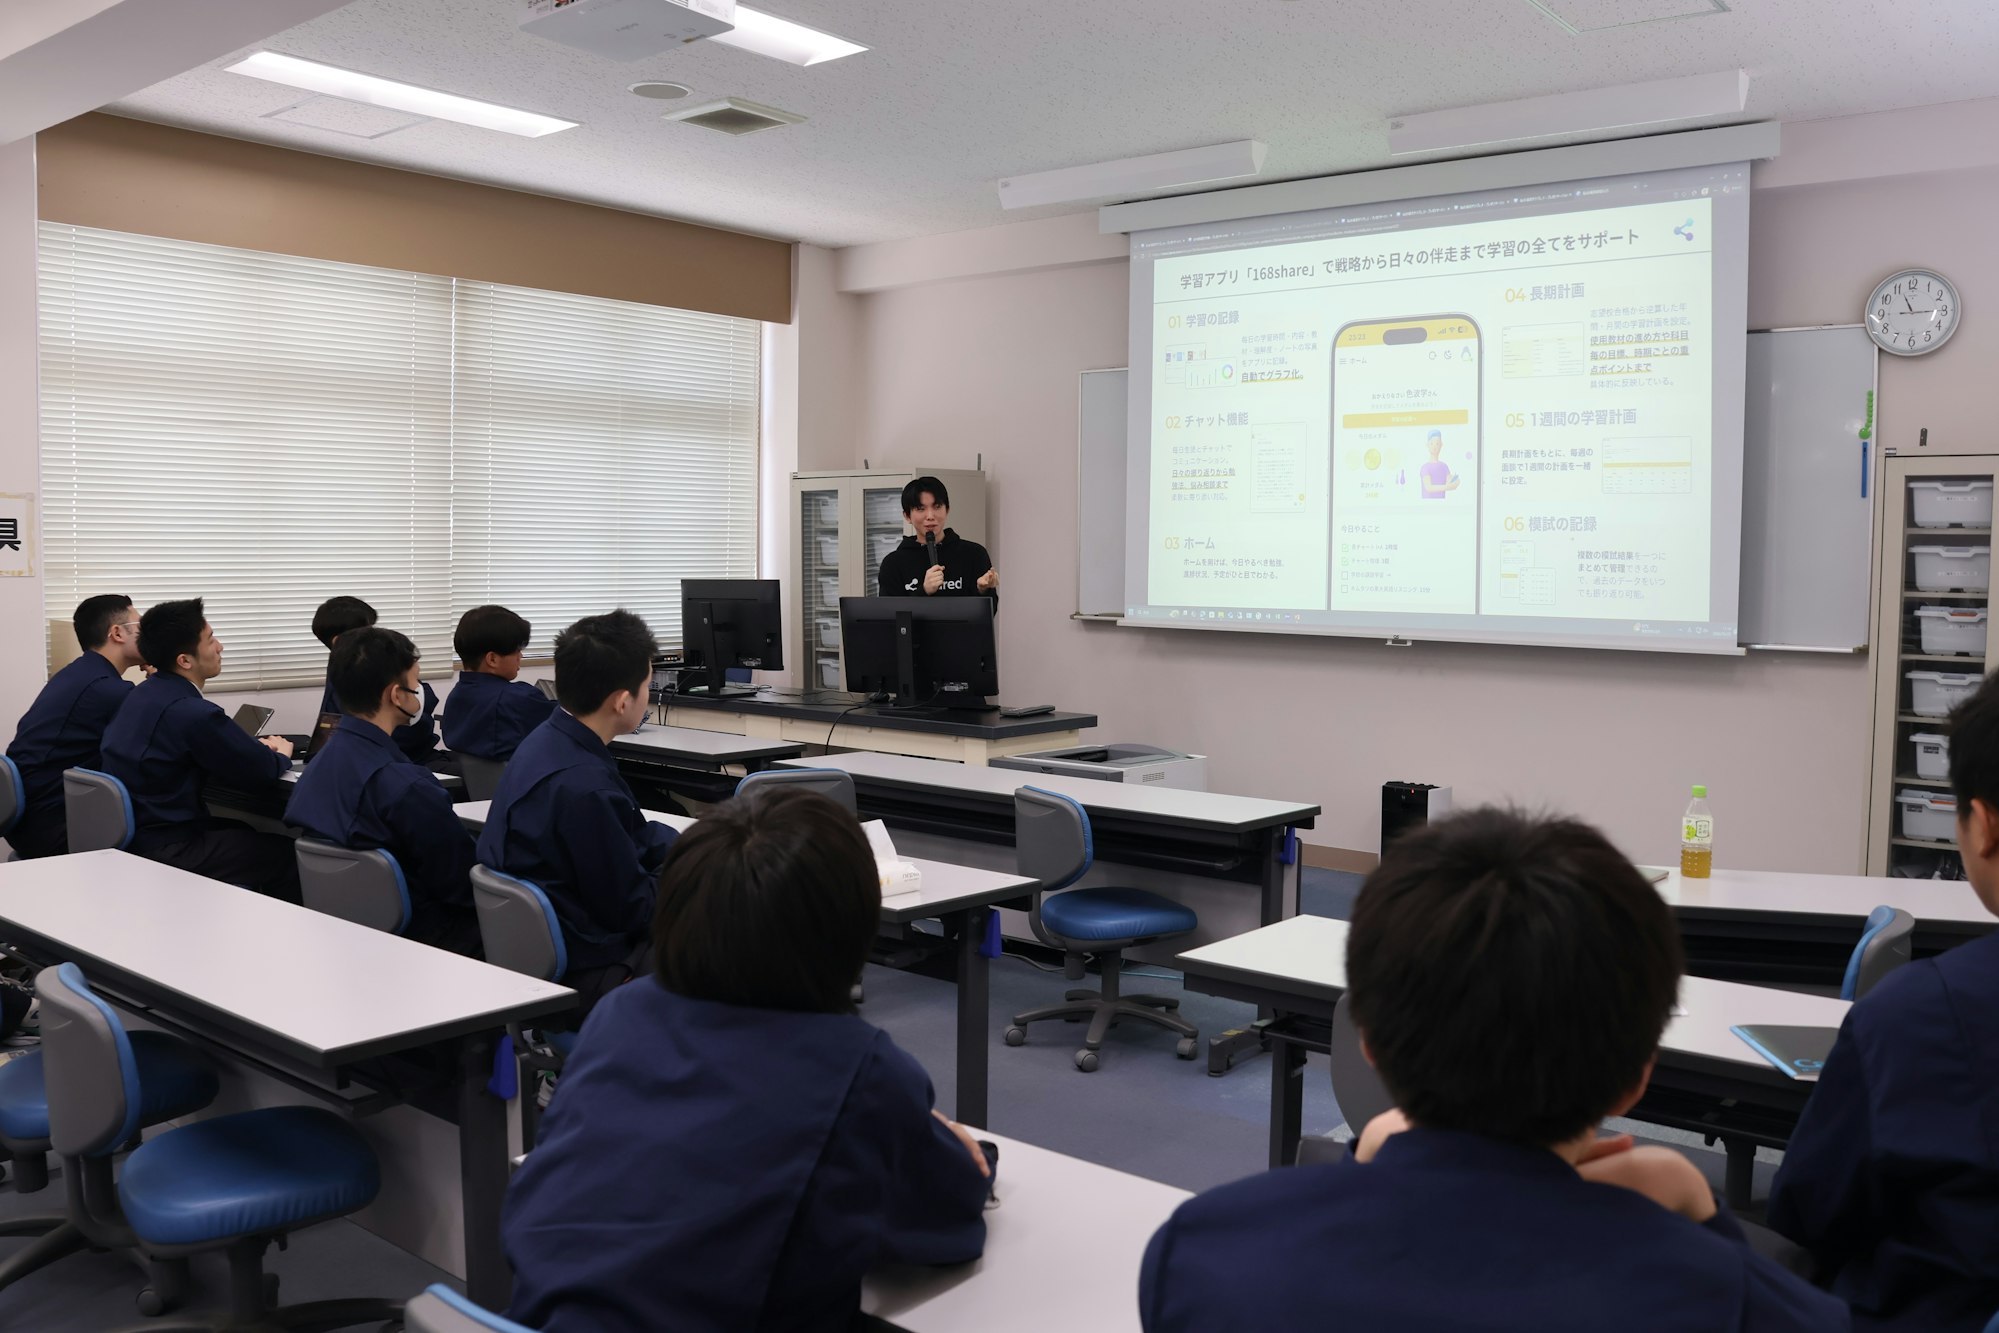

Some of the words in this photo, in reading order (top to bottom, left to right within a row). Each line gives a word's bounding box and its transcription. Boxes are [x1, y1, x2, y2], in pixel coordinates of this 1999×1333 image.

[1180, 229, 1640, 290] 学習アプリ「168share」で戦略から日々の伴走まで学習の全てをサポート
[1893, 283, 1902, 295] 11
[1908, 278, 1918, 290] 12
[1927, 281, 1931, 292] 1
[1505, 288, 1526, 303] 04
[1530, 282, 1585, 301] 長期計画
[1935, 290, 1943, 301] 2
[1881, 293, 1892, 305] 10
[1877, 309, 1885, 320] 9
[1940, 304, 1948, 317] 3
[1168, 315, 1181, 329] 01
[1186, 310, 1240, 328] 学習の記録
[1935, 319, 1942, 331] 4
[1881, 322, 1889, 334] 8
[1590, 329, 1689, 346] 使用教材の進め方や科目
[1893, 332, 1899, 343] 7
[1908, 336, 1915, 347] 6
[1923, 330, 1931, 342] 5
[1590, 362, 1652, 375] 点ポイントまで
[1241, 369, 1304, 383] 自動でグラフ化。
[1165, 415, 1181, 429] 02
[1184, 412, 1249, 429] チャット機能
[1505, 413, 1526, 428] 05
[1531, 408, 1637, 427] 1週間の学習計画
[1504, 516, 1525, 532] 06
[1529, 515, 1597, 533] 模試の記録
[1164, 536, 1180, 550] 03
[1183, 536, 1216, 550] ホーム
[1577, 563, 1658, 574] まとめて管理できるの
[939, 576, 962, 590] red
[1577, 588, 1647, 600] でも振り返り可能。
